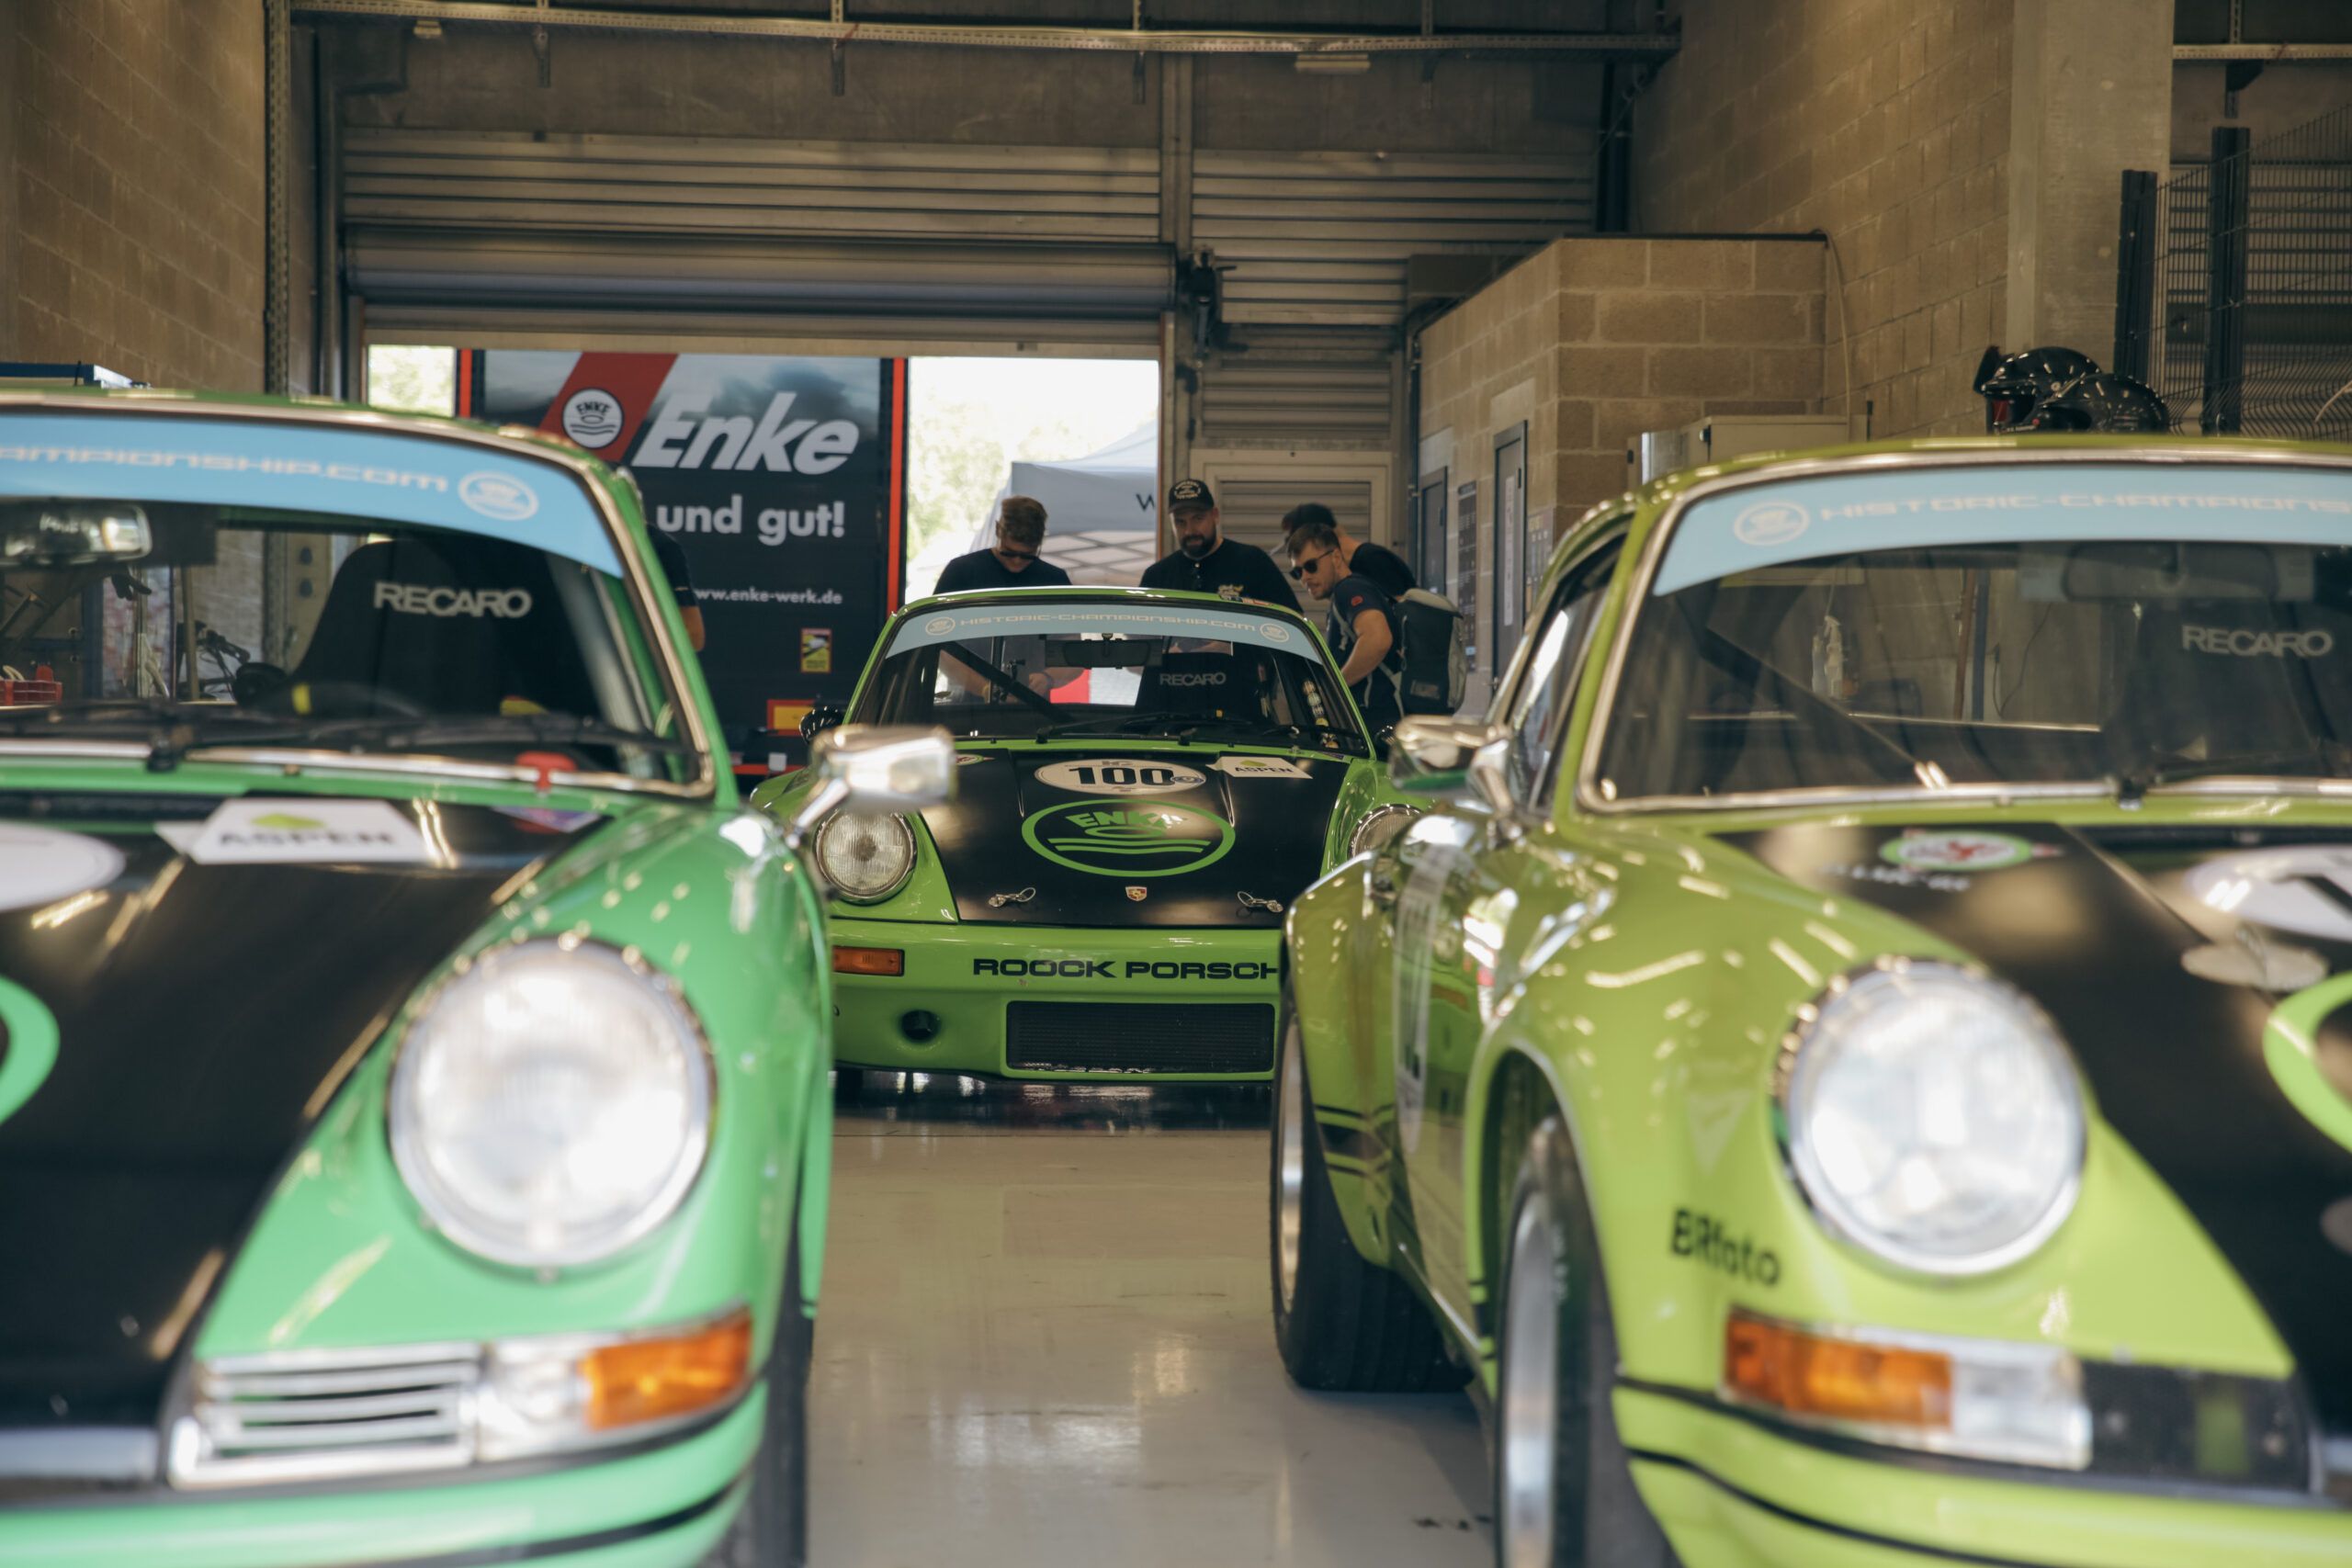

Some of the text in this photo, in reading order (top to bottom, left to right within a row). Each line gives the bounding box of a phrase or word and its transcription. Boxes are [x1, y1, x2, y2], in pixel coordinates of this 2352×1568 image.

[630, 391, 860, 475] Enke
[656, 494, 845, 547] und gut!
[373, 581, 532, 618] RECARO
[2182, 625, 2334, 658] RECARO
[1159, 672, 1227, 686] RECARO
[1069, 767, 1175, 786] 100
[973, 958, 1117, 979] ROOCK
